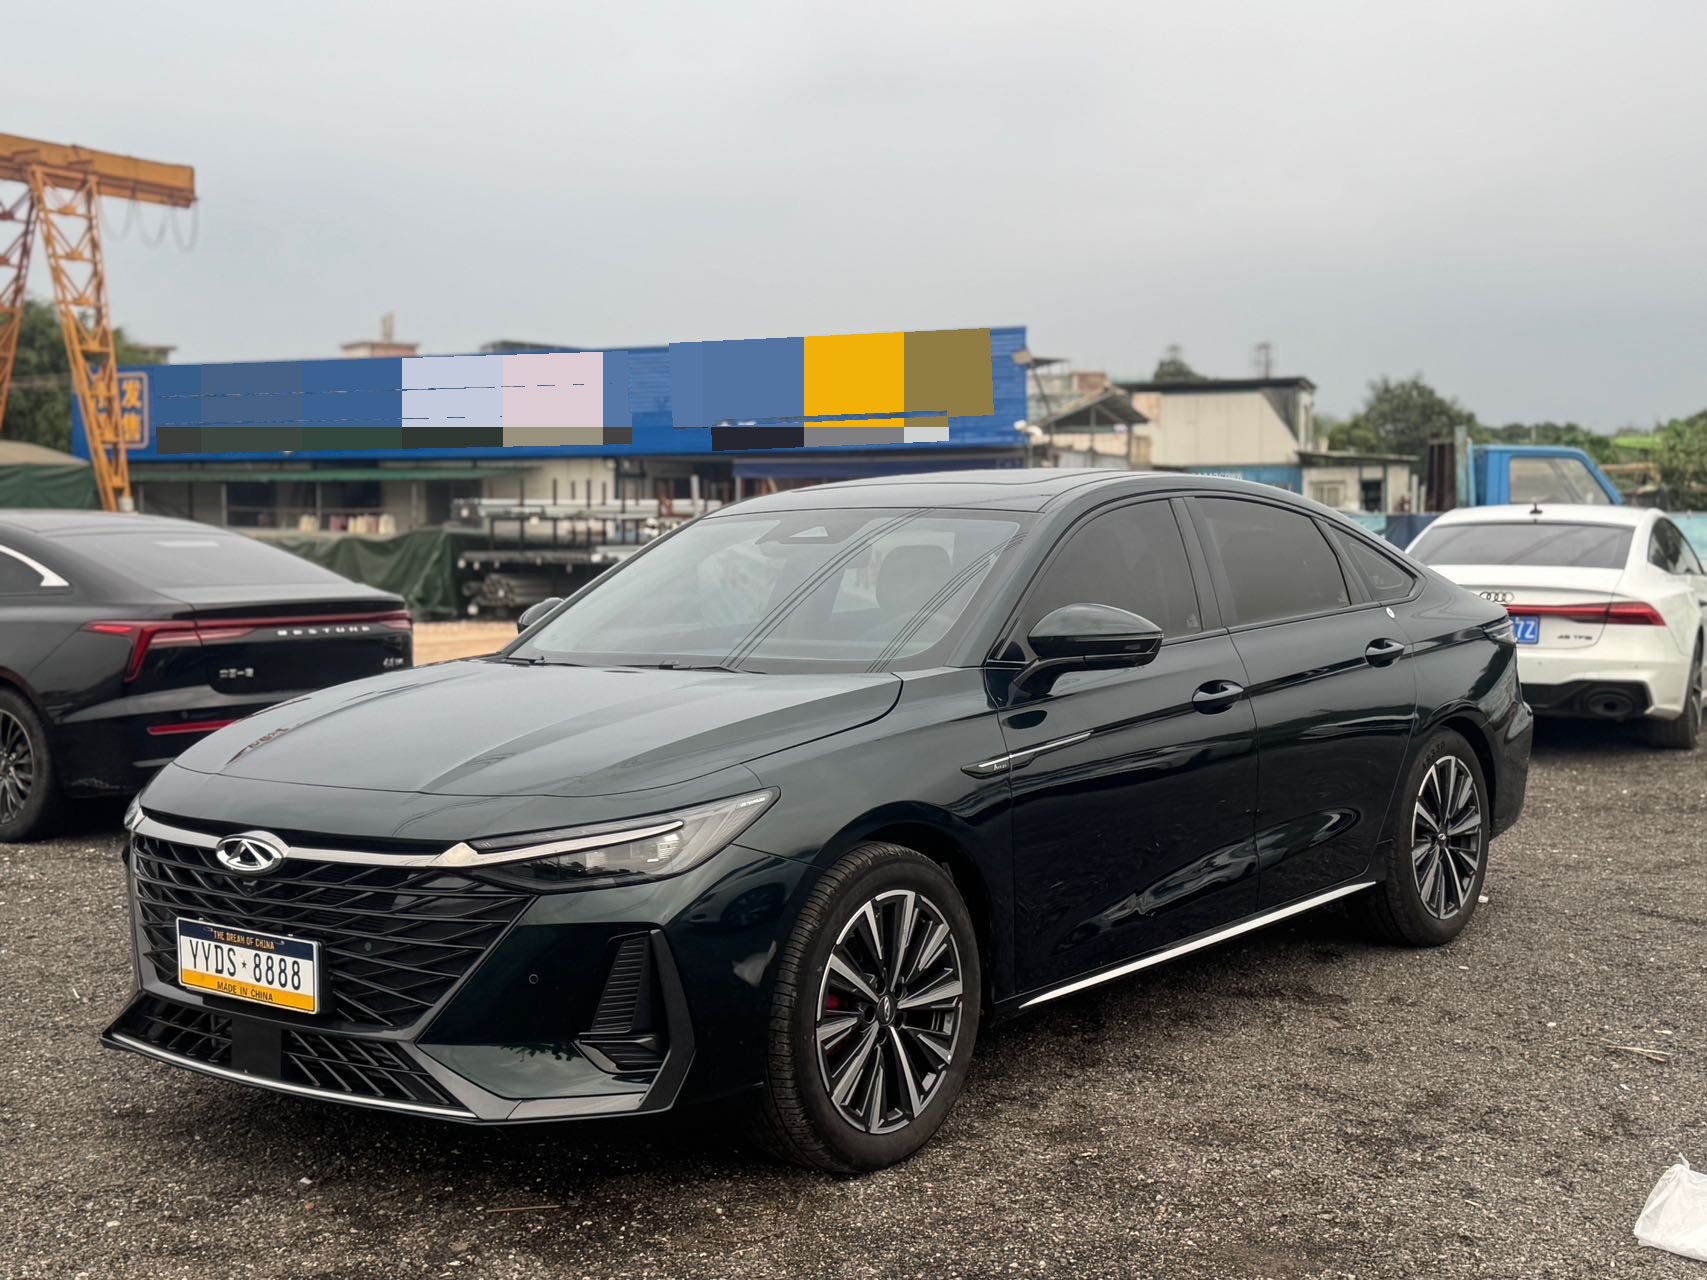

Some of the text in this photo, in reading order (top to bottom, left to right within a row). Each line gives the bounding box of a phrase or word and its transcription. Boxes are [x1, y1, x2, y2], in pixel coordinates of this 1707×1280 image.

[212, 930, 275, 950] THE DREAM OF CHINA
[189, 939, 301, 991] YYDS 8888
[216, 981, 273, 1002] MADE IN CHINA
